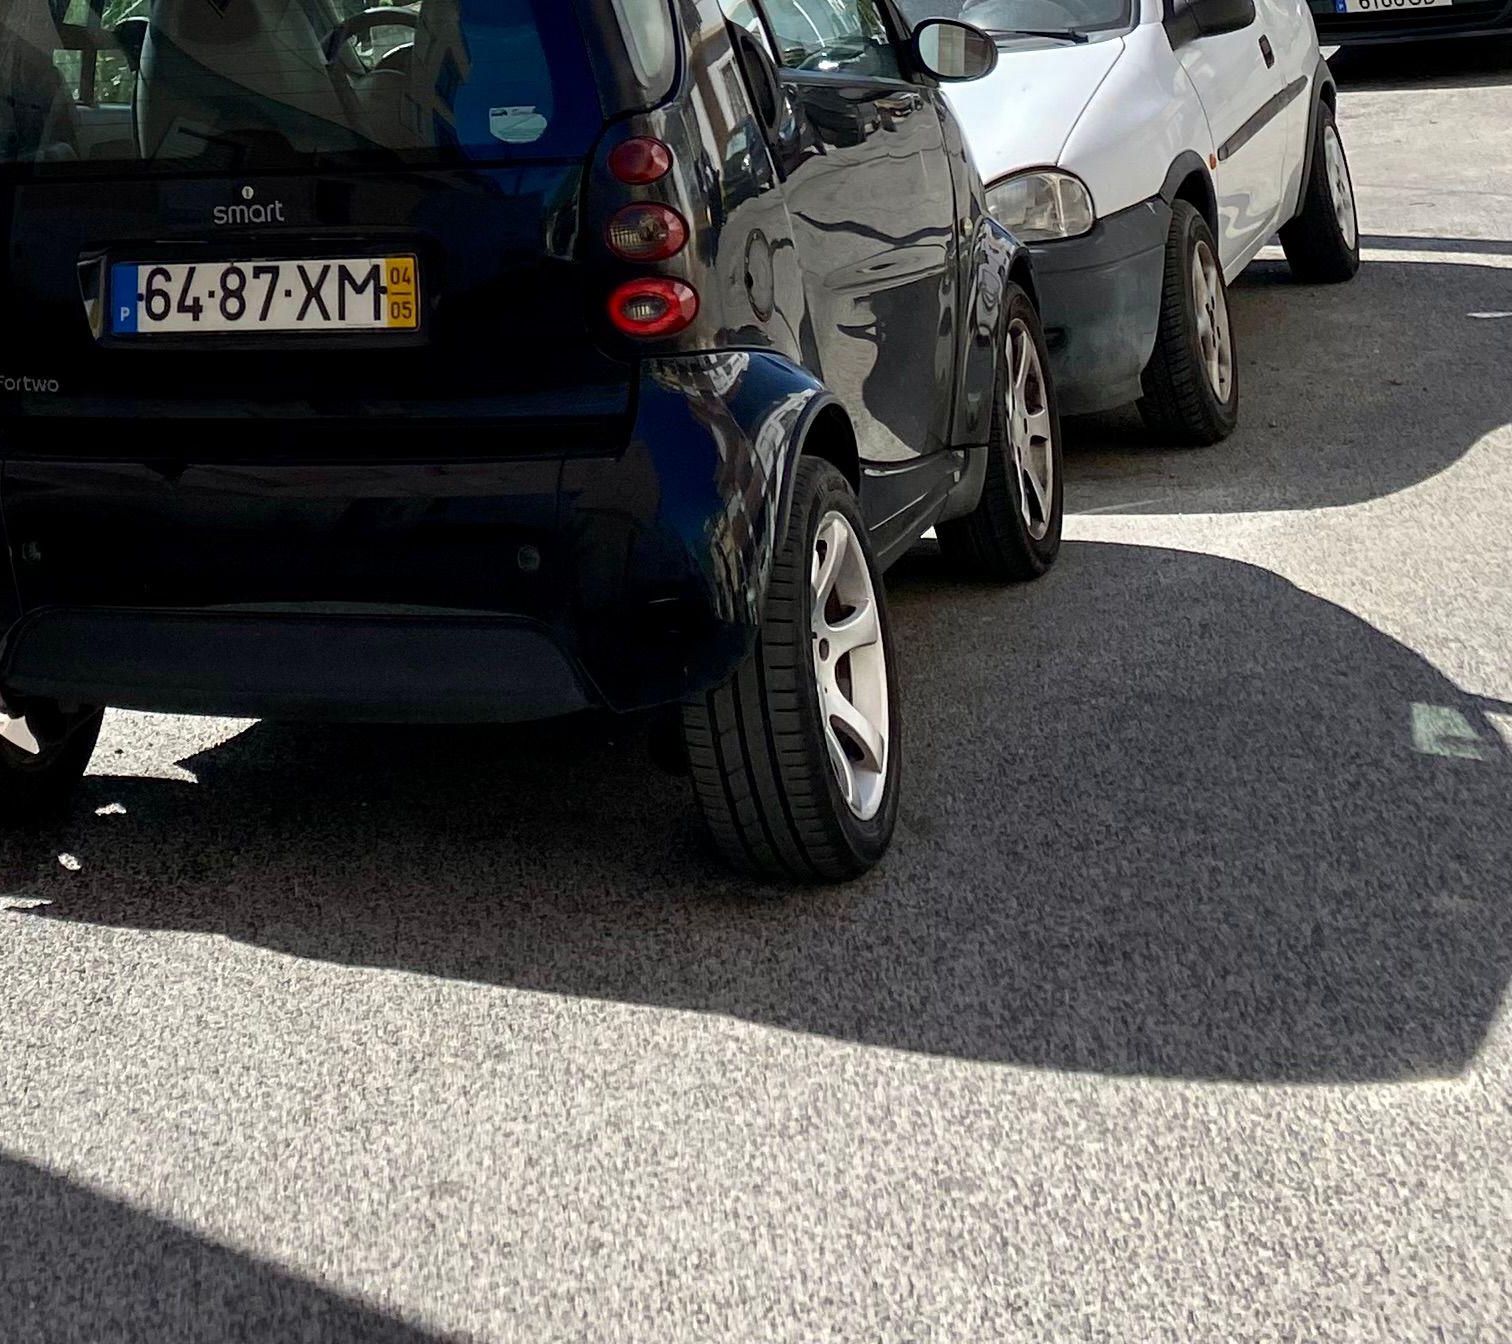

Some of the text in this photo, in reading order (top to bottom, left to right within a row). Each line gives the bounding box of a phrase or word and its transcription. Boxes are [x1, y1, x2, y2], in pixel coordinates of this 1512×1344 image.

[213, 200, 285, 225] smart
[389, 266, 412, 286] 04
[119, 306, 131, 322] P
[390, 301, 412, 320] 05
